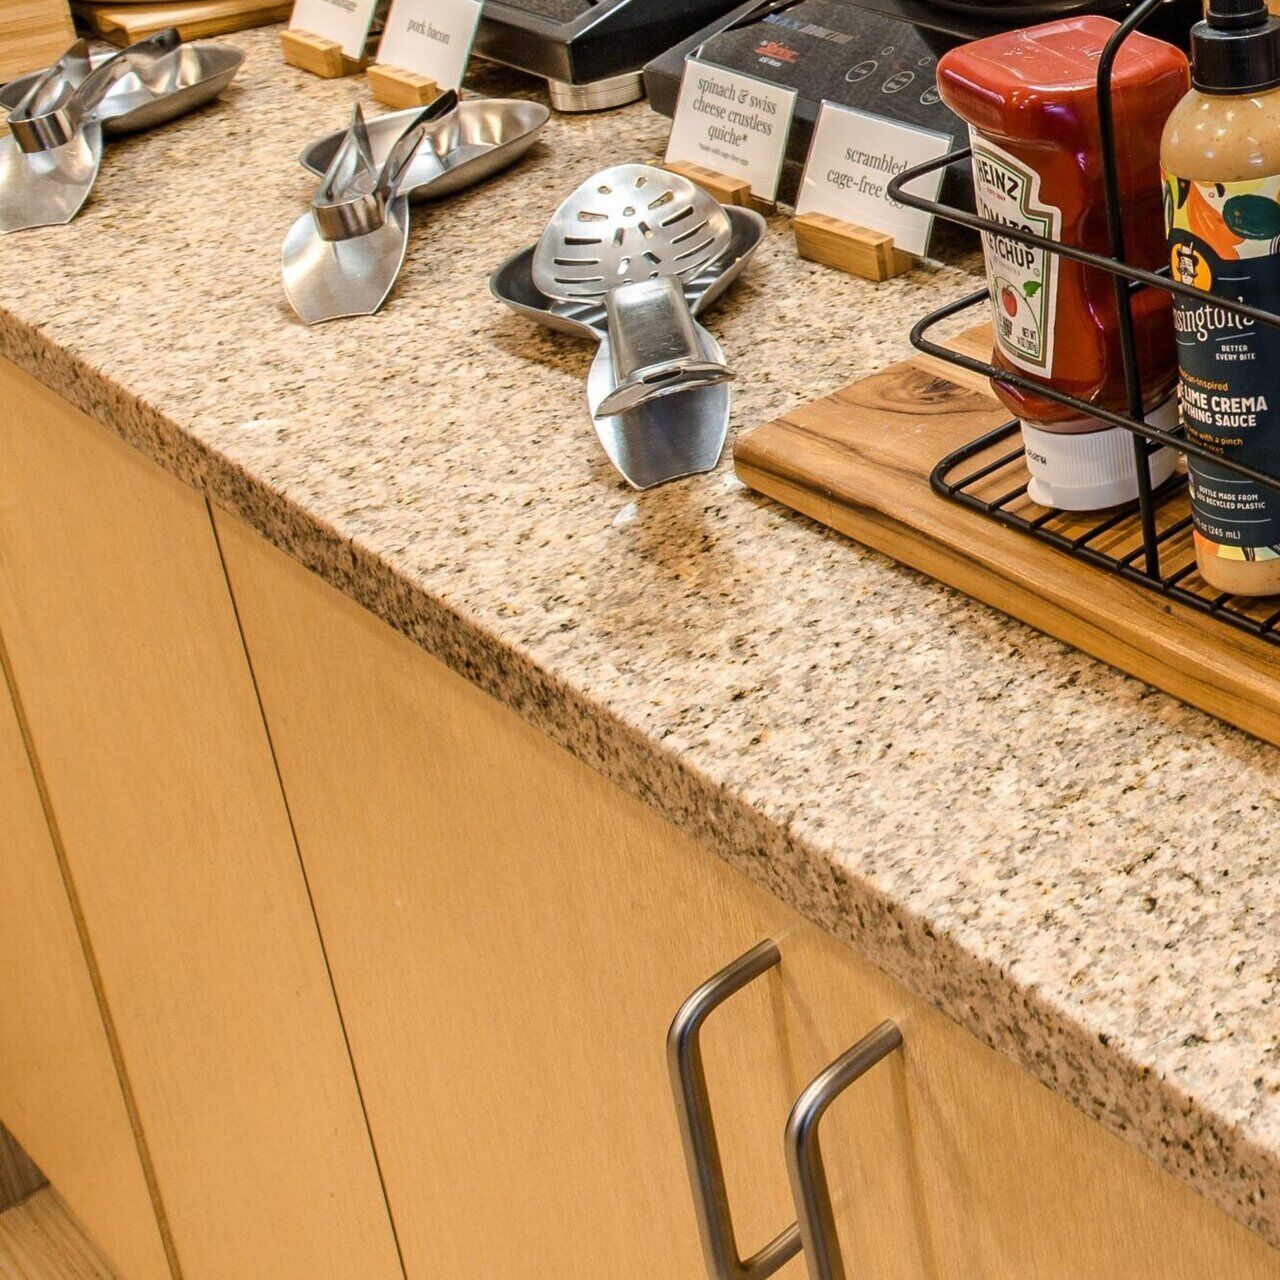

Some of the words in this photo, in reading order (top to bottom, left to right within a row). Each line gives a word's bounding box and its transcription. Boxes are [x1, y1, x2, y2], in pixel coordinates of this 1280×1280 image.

[407, 18, 427, 36] pork
[428, 22, 451, 45] bacon
[697, 78, 736, 102] spinach
[737, 89, 749, 104] &
[749, 95, 777, 115] swiss
[693, 96, 726, 120] cheese
[728, 109, 773, 136] crustless
[845, 147, 907, 176] scrambled
[827, 169, 883, 198] cage-free
[977, 158, 1019, 201] HEINZ
[1215, 353, 1237, 361] EVERY
[1184, 384, 1208, 409] LIME
[1211, 396, 1268, 413] CREMA
[1215, 414, 1257, 427] SAUCE
[1222, 437, 1243, 446] pinch
[1199, 485, 1217, 498] BOTTLE
[1218, 493, 1236, 501] MADE
[1206, 496, 1235, 509] RECYCLED
[1237, 501, 1266, 509] PLASTIC
